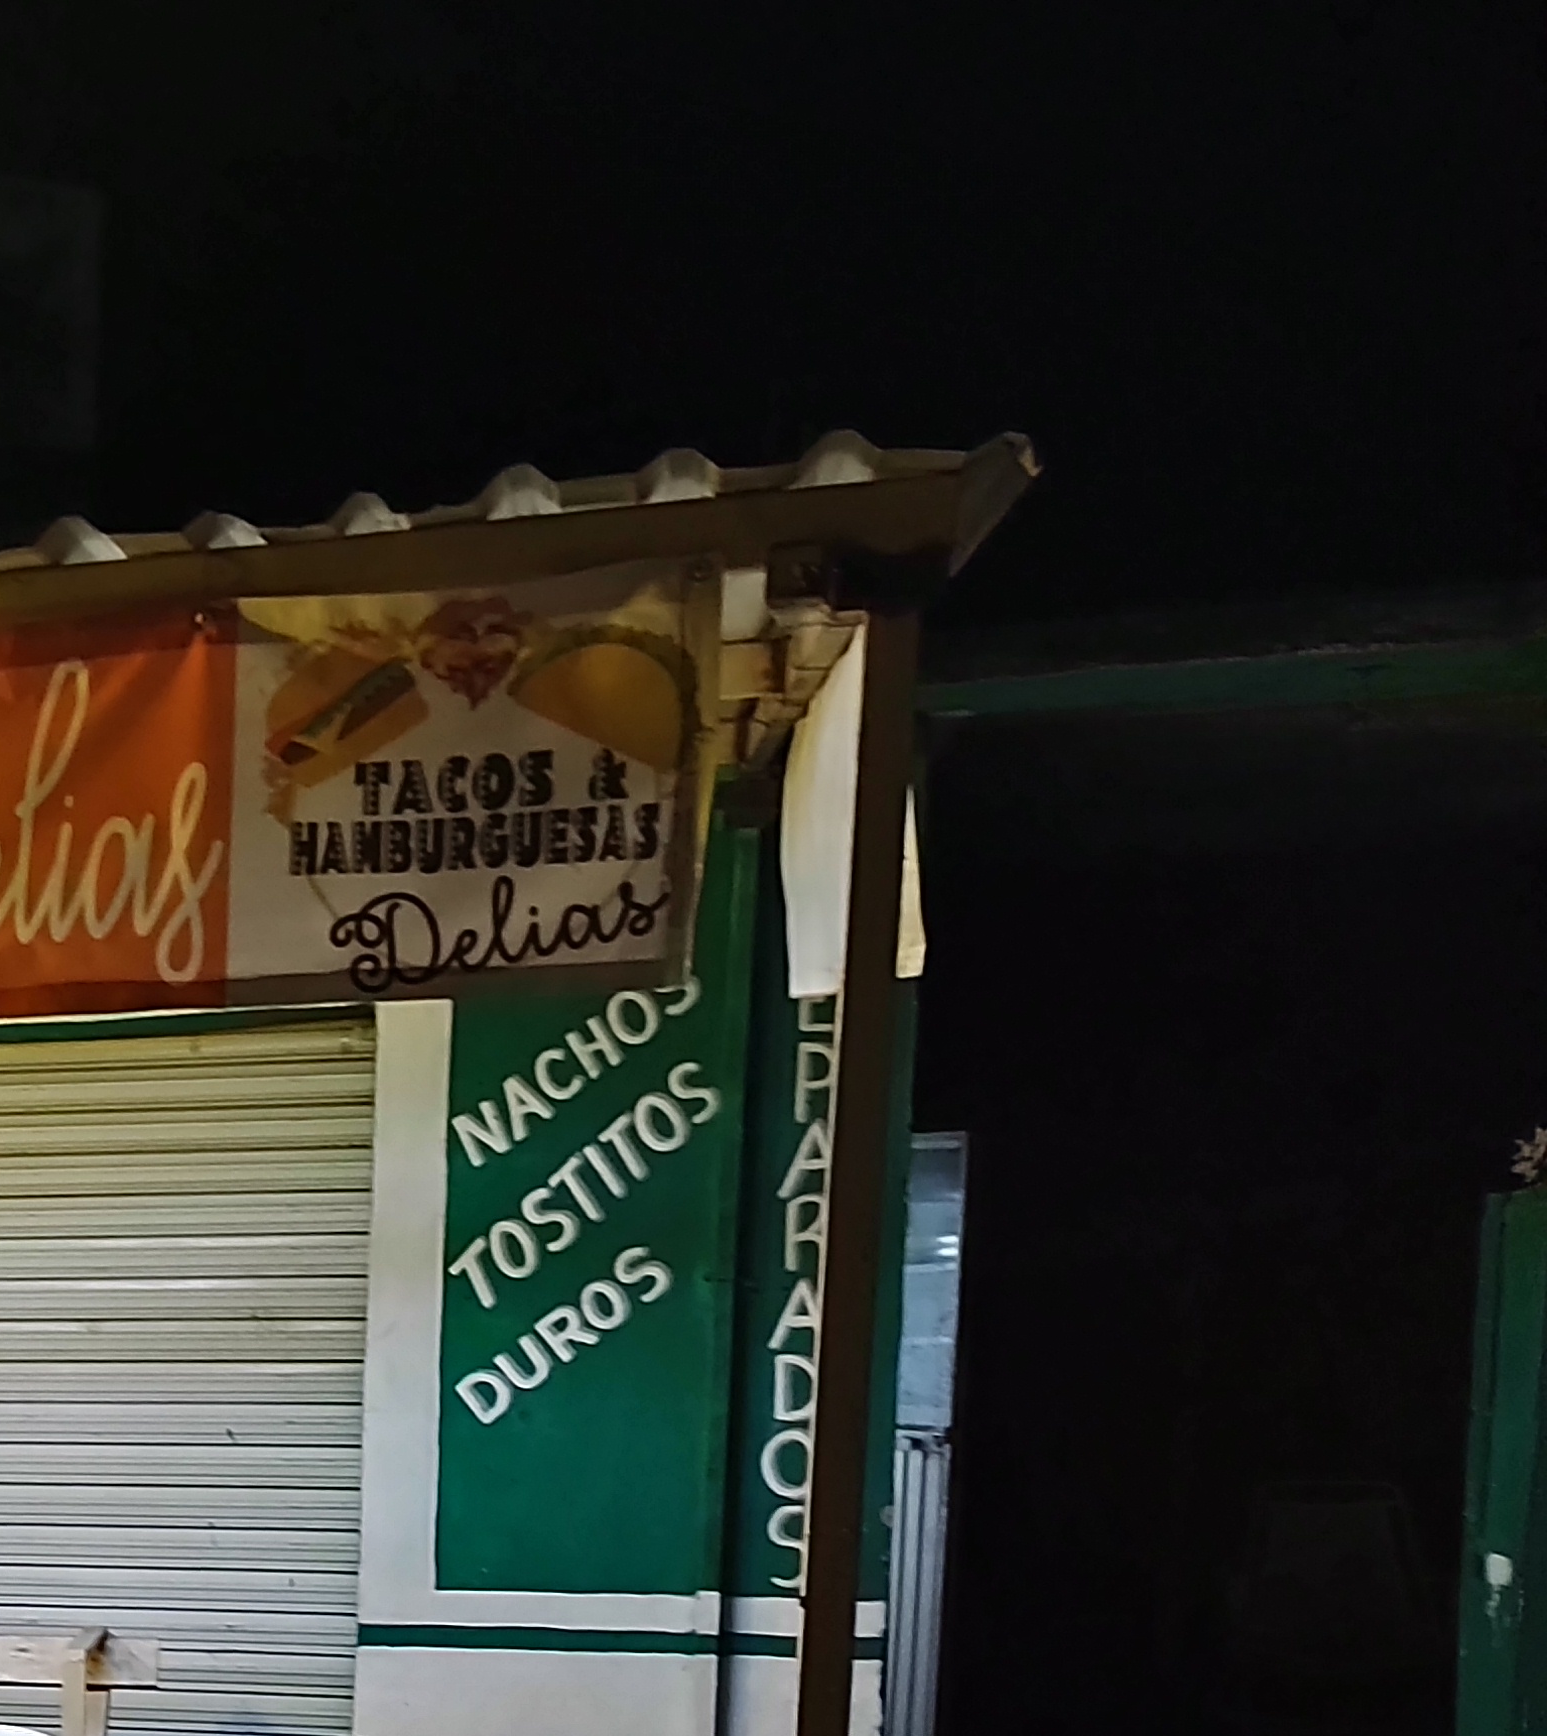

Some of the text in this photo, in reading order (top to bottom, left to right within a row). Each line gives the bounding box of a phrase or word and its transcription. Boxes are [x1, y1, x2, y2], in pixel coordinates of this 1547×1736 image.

[353, 747, 630, 816] TACOS &
[328, 875, 671, 994] Delias
[448, 1060, 722, 1310] TOSTITOS
[454, 1245, 674, 1425] DUROS
